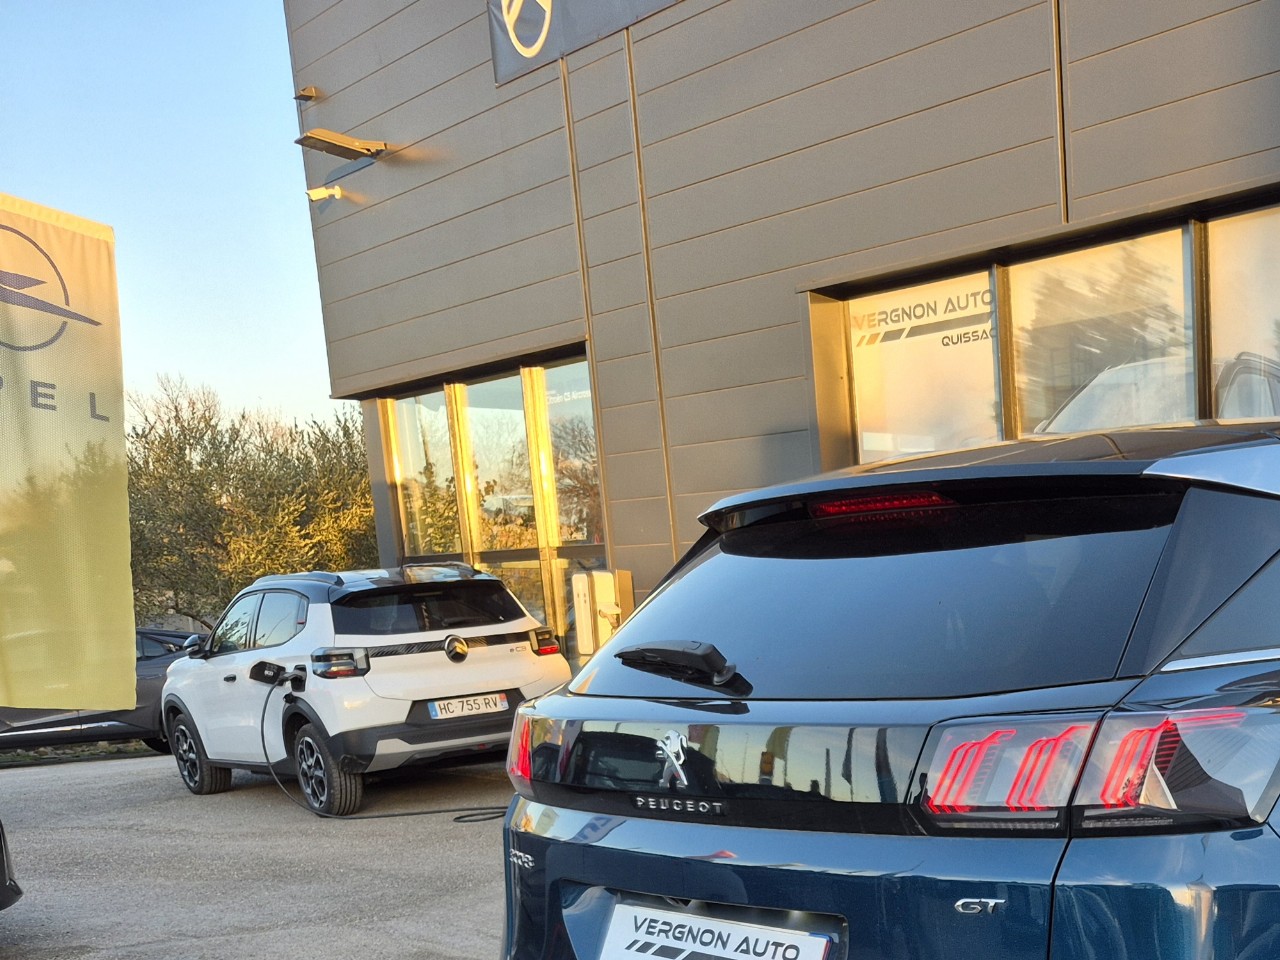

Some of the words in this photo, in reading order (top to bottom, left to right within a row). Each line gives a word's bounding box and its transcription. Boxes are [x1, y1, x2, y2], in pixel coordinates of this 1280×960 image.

[853, 300, 937, 330] VERGNON
[943, 289, 994, 315] AUTO
[636, 797, 722, 815] PEUGEOT
[954, 898, 1006, 914] GT
[633, 915, 731, 950] VERGNON
